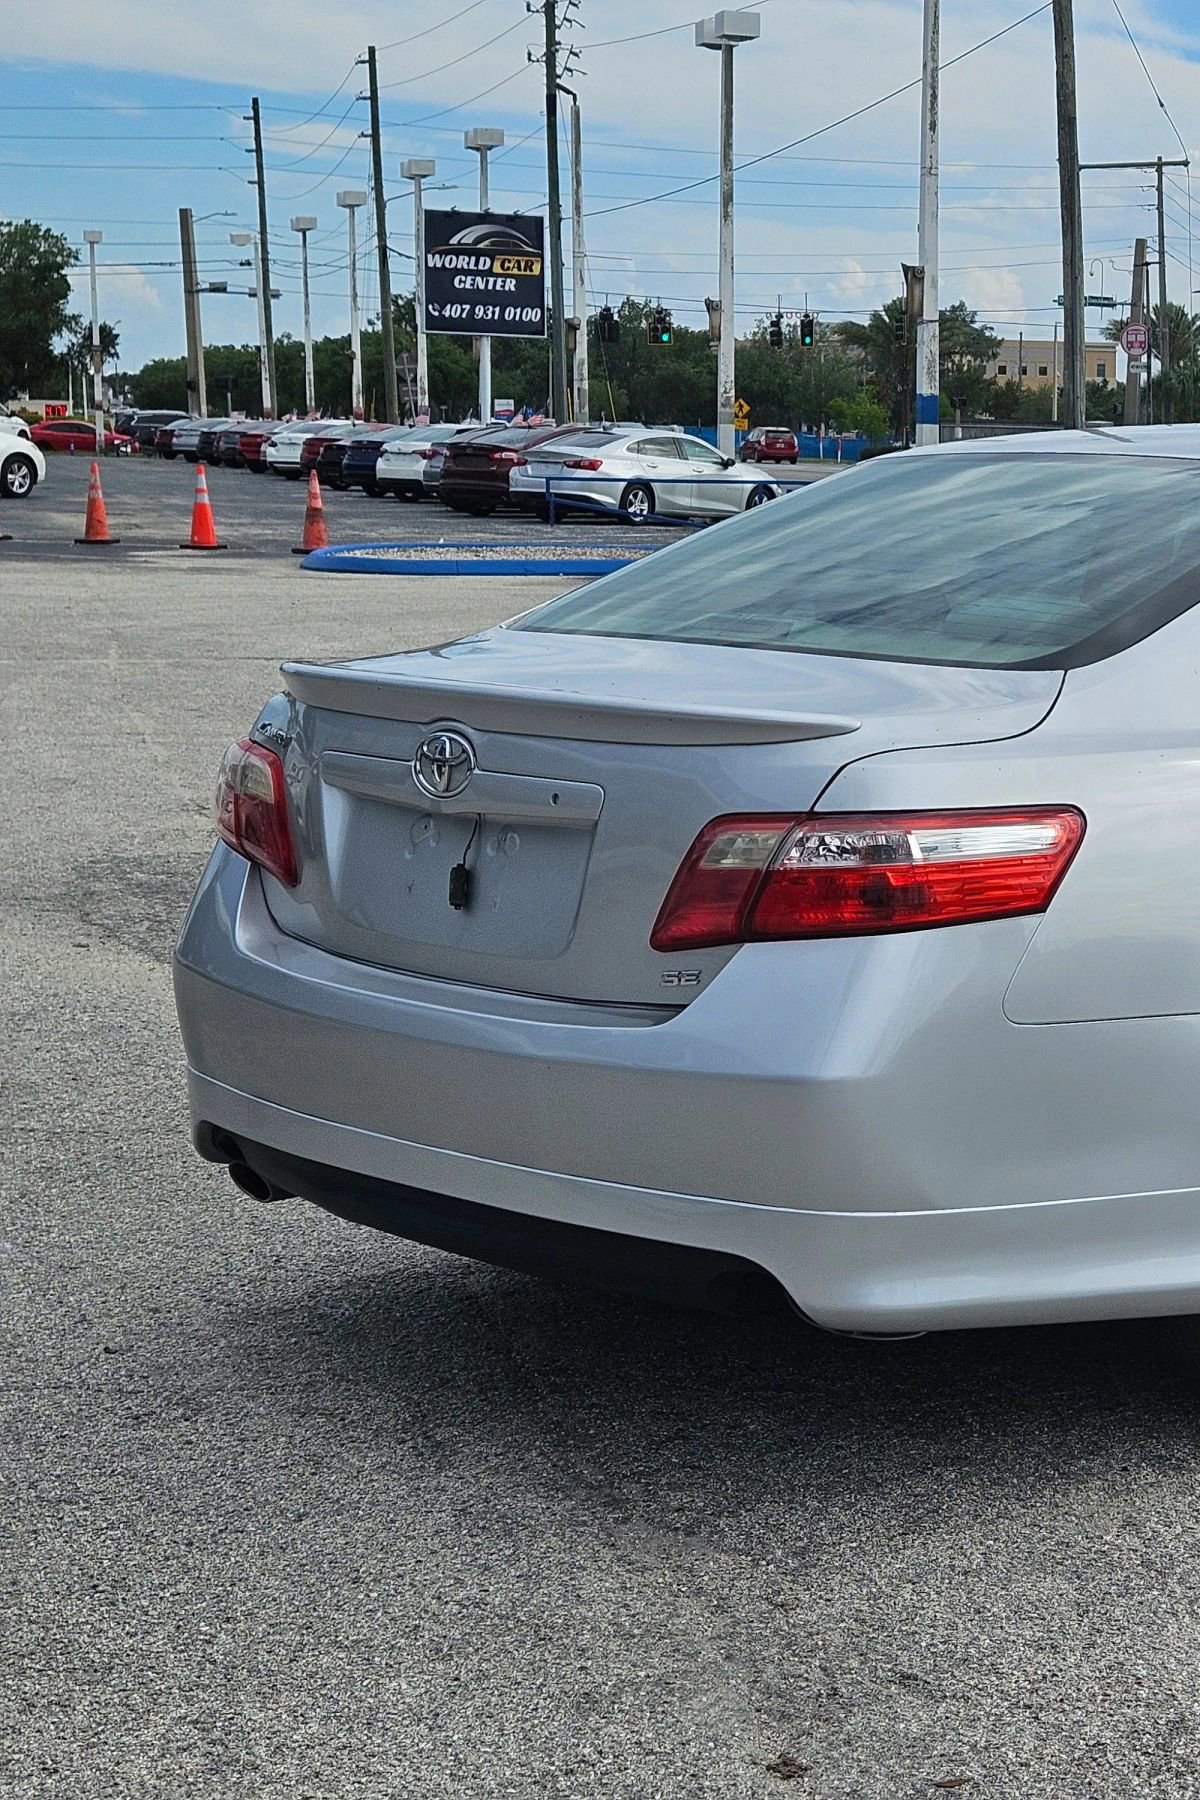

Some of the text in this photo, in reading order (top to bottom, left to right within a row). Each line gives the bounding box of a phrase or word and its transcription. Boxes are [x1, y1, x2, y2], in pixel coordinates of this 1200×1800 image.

[427, 253, 535, 273] WORLD CAR
[453, 274, 517, 292] CENTER
[441, 303, 542, 322] 407 931 0100
[660, 969, 703, 987] SE
